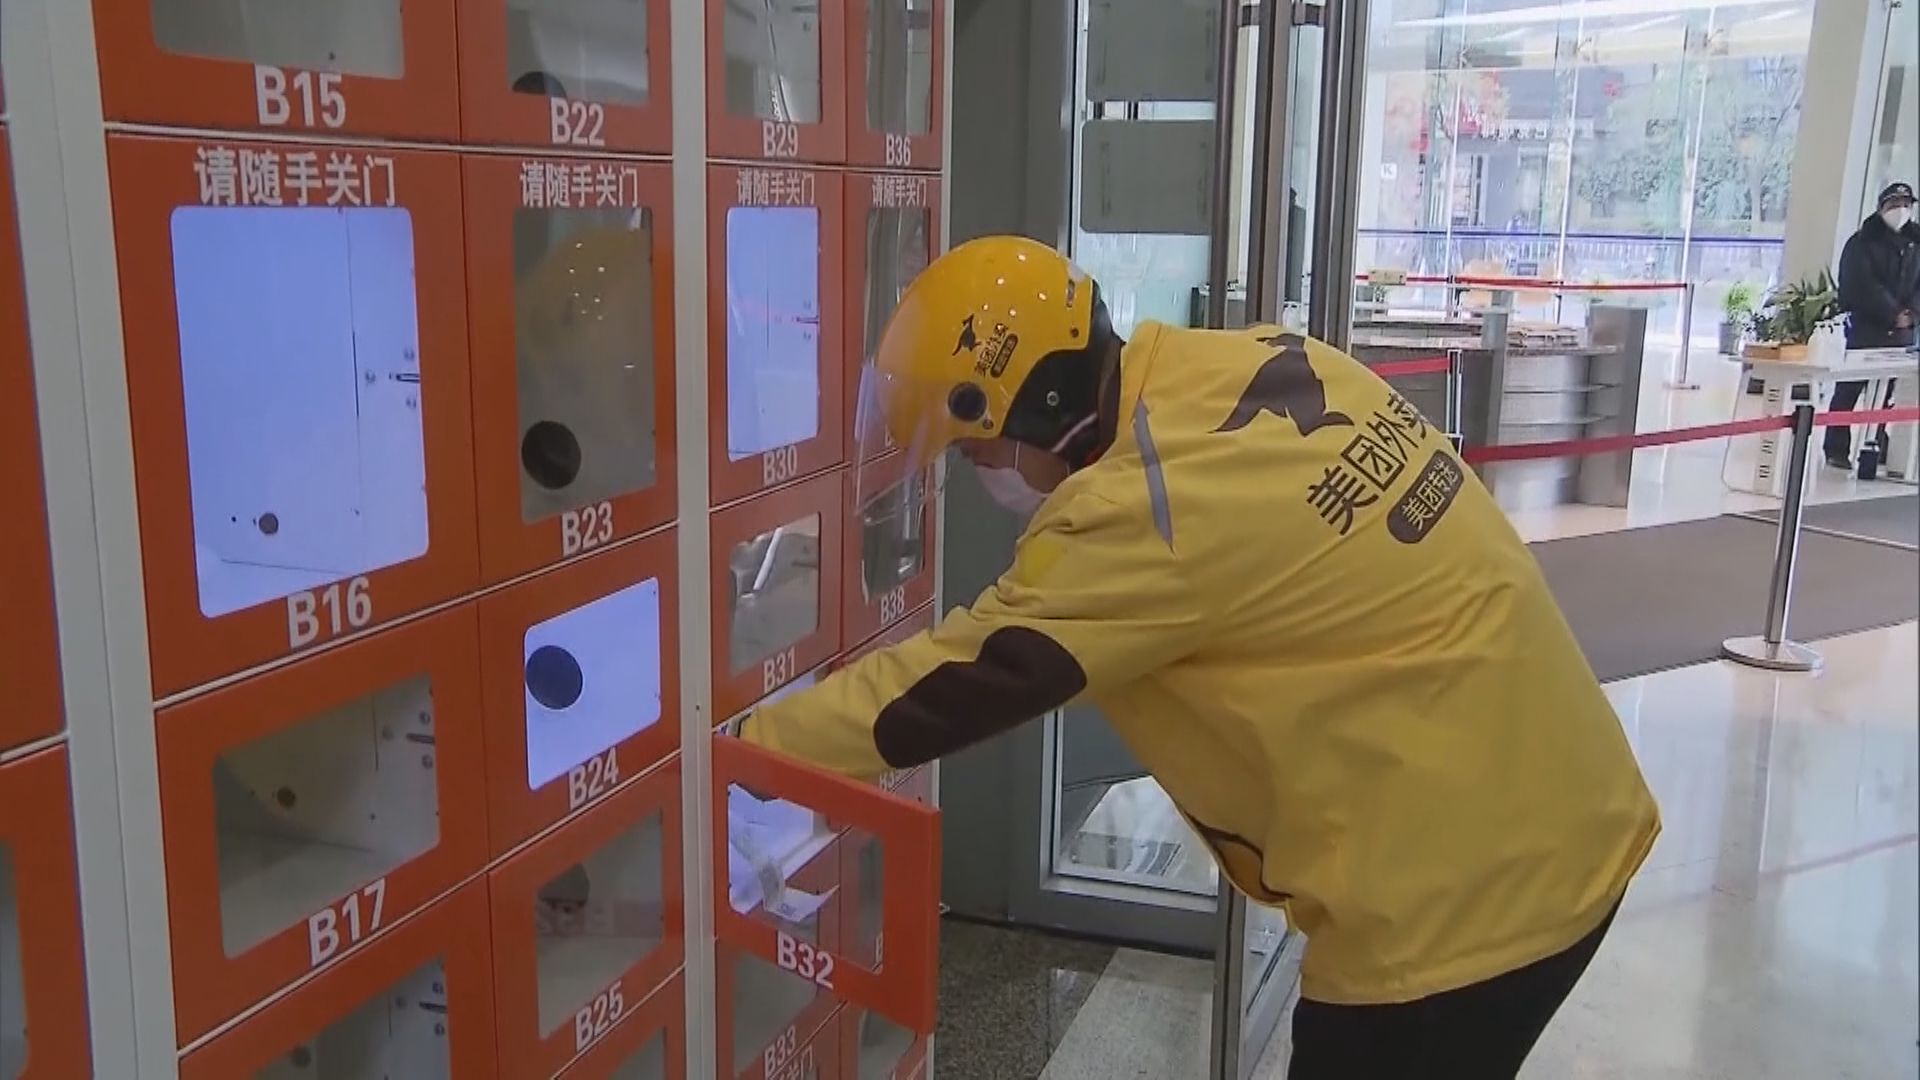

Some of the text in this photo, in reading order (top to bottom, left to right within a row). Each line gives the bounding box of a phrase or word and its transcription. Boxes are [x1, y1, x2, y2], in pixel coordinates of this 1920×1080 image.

[255, 64, 346, 129] B15
[550, 96, 605, 146] B22
[762, 119, 799, 158] B29
[886, 133, 912, 166] B36
[194, 146, 396, 207] 请随手关门
[519, 161, 639, 208] 请随手关门
[736, 168, 816, 206] 请随手关门
[872, 175, 928, 208] 请随手关门
[762, 444, 798, 486] B30
[561, 501, 614, 556] B23
[287, 576, 373, 649] B16
[880, 586, 905, 625] B38
[763, 646, 796, 693] B31
[568, 746, 620, 812] B24
[308, 878, 387, 967] B17
[777, 929, 835, 990] B32
[574, 981, 625, 1052] B25
[764, 1024, 797, 1079] B33
